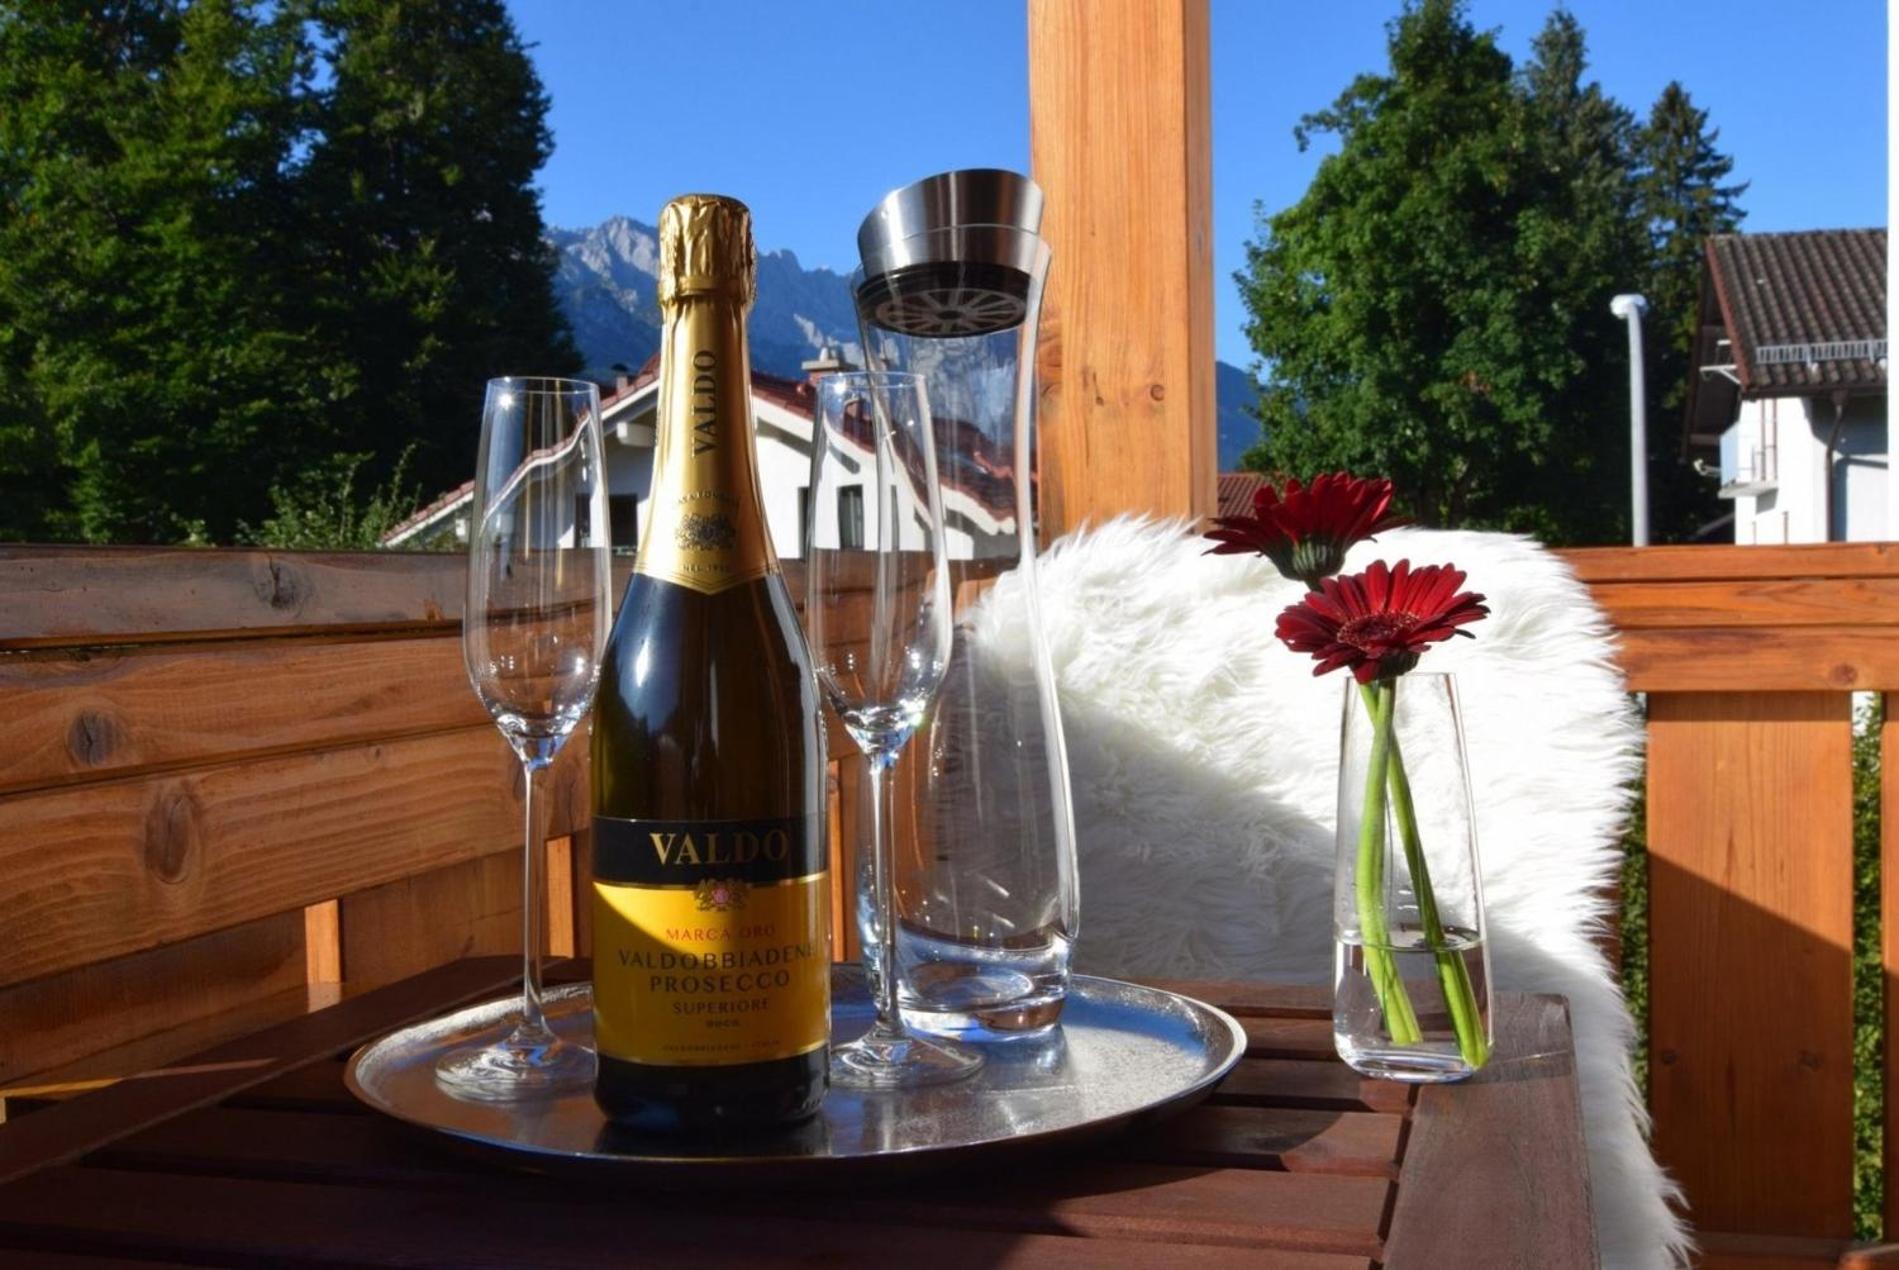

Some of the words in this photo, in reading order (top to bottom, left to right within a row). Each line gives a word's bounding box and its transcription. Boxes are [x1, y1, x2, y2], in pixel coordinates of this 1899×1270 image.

[692, 350, 717, 460] VALDO
[650, 829, 789, 865] VALDO
[666, 927, 731, 941] MARCA
[617, 944, 815, 970] VALDOBBIADEN
[650, 970, 790, 994] PROSECCO
[672, 998, 768, 1015] SUPERIORE
